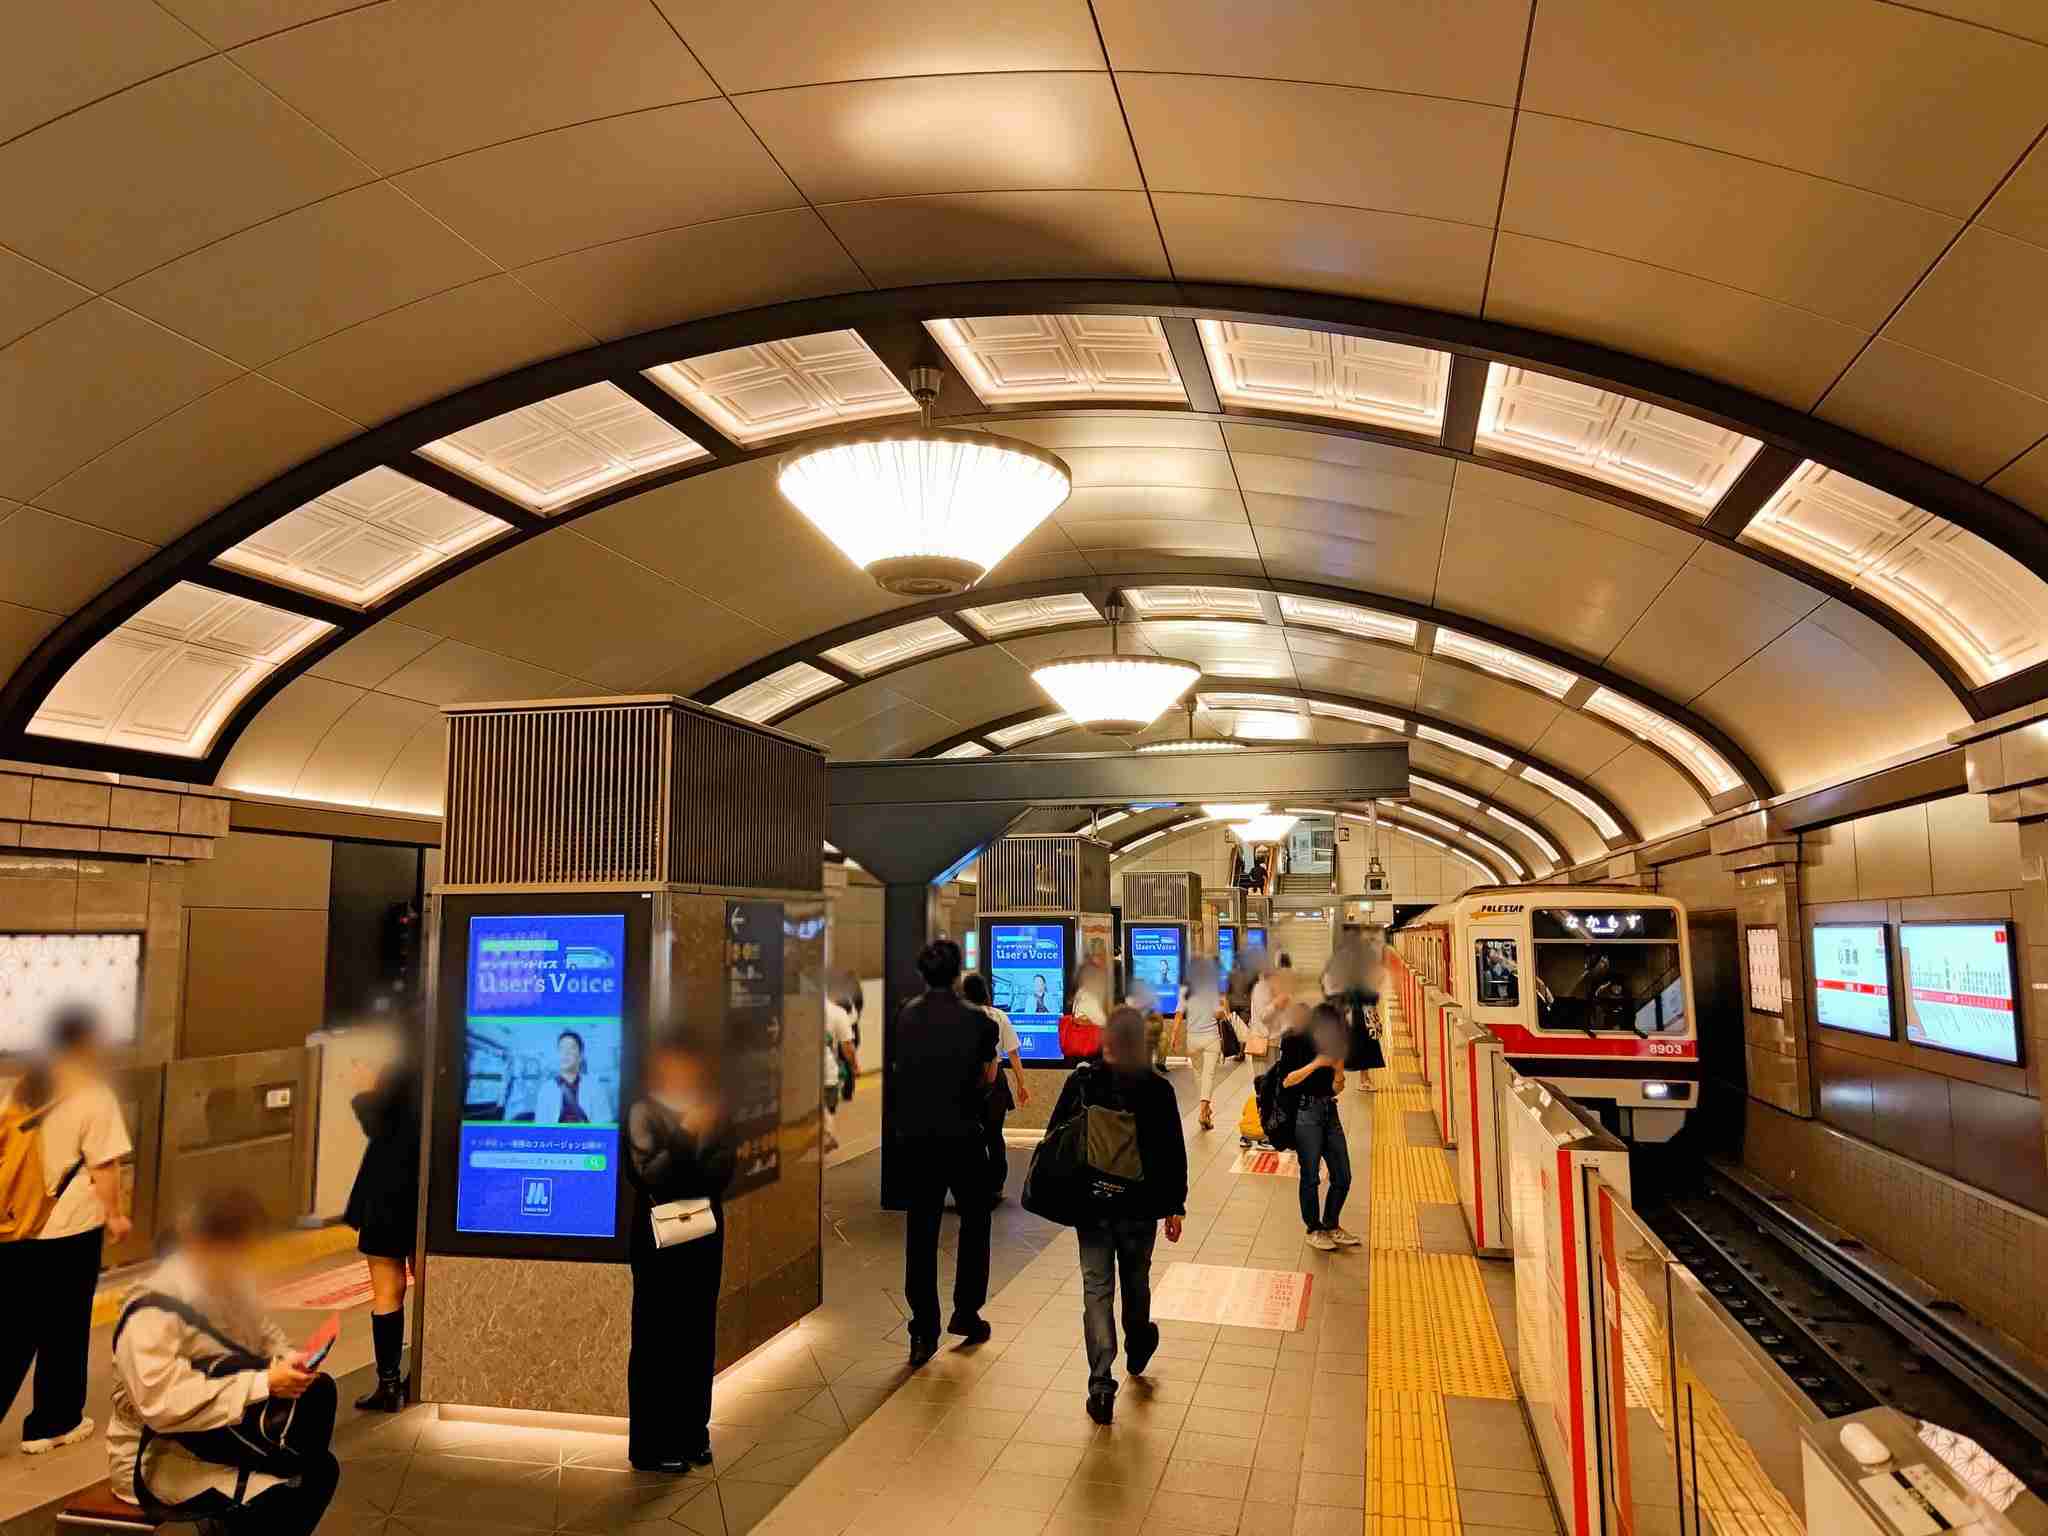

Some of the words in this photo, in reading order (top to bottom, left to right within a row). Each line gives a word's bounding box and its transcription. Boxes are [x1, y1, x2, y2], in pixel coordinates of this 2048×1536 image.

[1565, 914, 1641, 929] なかもず
[996, 949, 1028, 960] User's
[1028, 949, 1058, 960] Voice
[478, 972, 546, 993] User's
[549, 972, 615, 993] Voice
[1649, 1043, 1682, 1055] 8903
